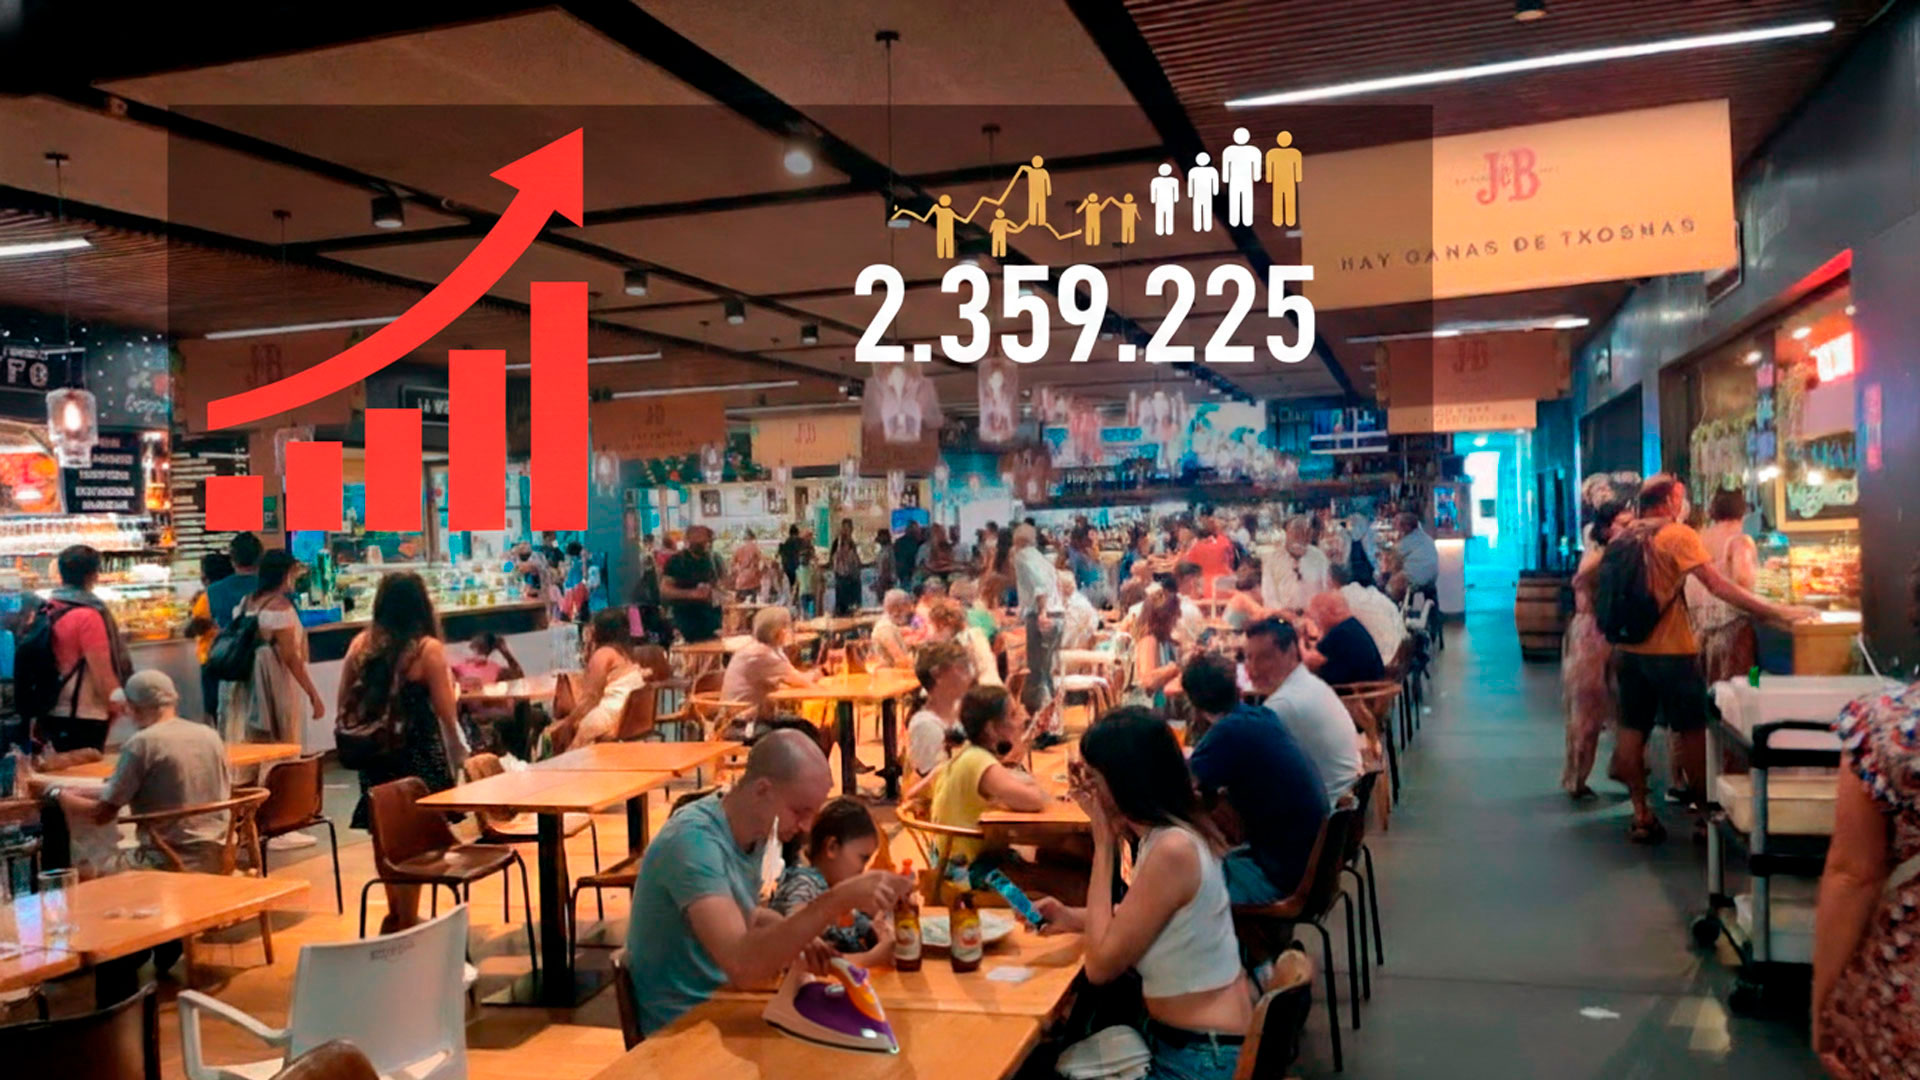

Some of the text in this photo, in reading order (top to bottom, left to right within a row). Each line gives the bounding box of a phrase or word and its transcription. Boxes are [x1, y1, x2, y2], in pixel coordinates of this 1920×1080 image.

[1475, 147, 1541, 206] J&B
[1340, 253, 1391, 272] HAY
[1513, 234, 1546, 253] DE
